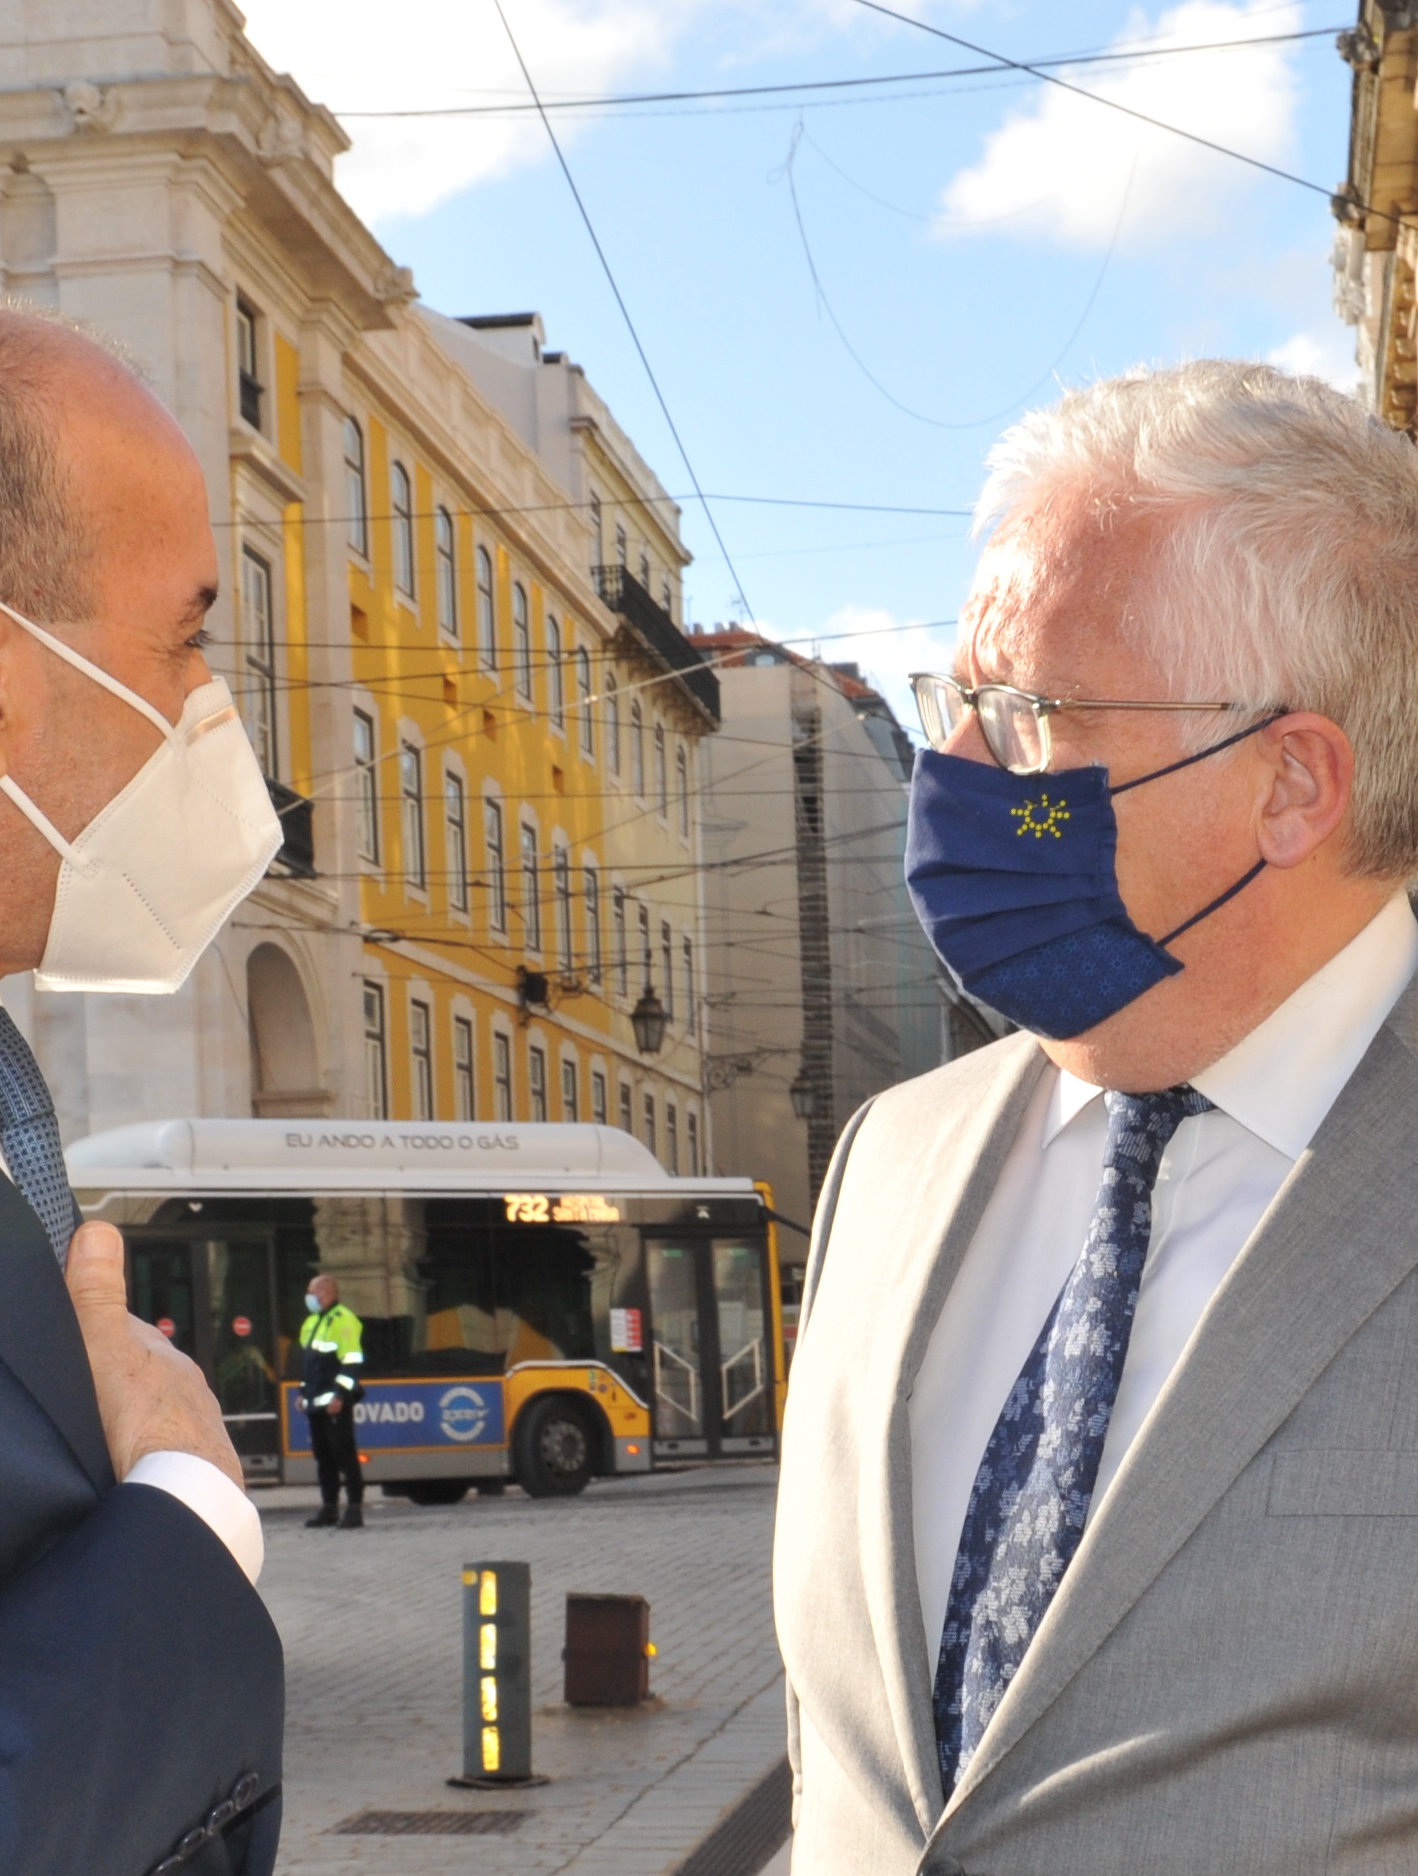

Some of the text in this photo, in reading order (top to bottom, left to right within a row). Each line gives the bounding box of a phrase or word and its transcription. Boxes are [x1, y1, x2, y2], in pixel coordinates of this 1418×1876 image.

[284, 1132, 313, 1149] EU
[317, 1133, 376, 1150] ANDO
[381, 1134, 396, 1149] A
[398, 1134, 454, 1150] TODO
[457, 1134, 474, 1150] O
[504, 1194, 549, 1222] 732
